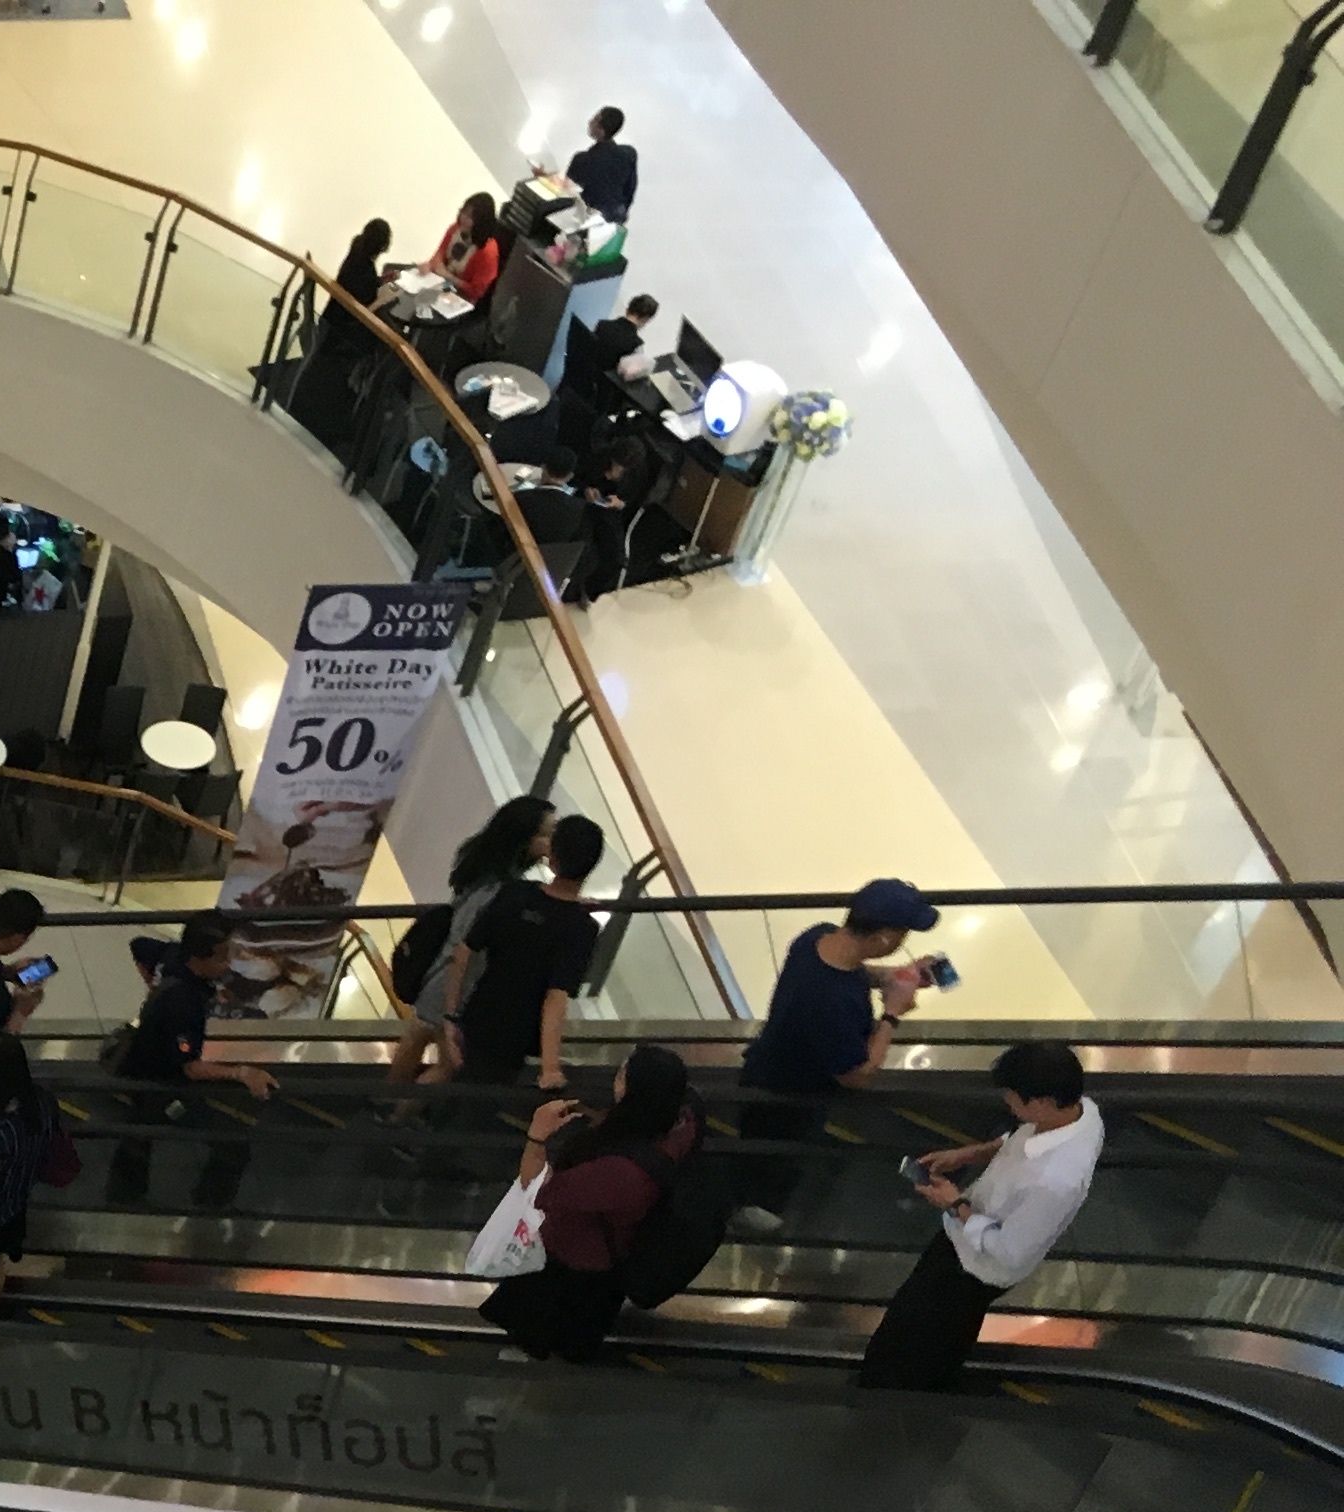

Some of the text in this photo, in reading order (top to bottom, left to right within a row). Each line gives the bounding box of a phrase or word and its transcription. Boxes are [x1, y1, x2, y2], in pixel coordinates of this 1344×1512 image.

[383, 602, 455, 620] NOW
[372, 620, 454, 638] OPEN
[305, 657, 437, 682] White Day
[275, 716, 404, 776] 50%
[70, 1386, 111, 1437] B
